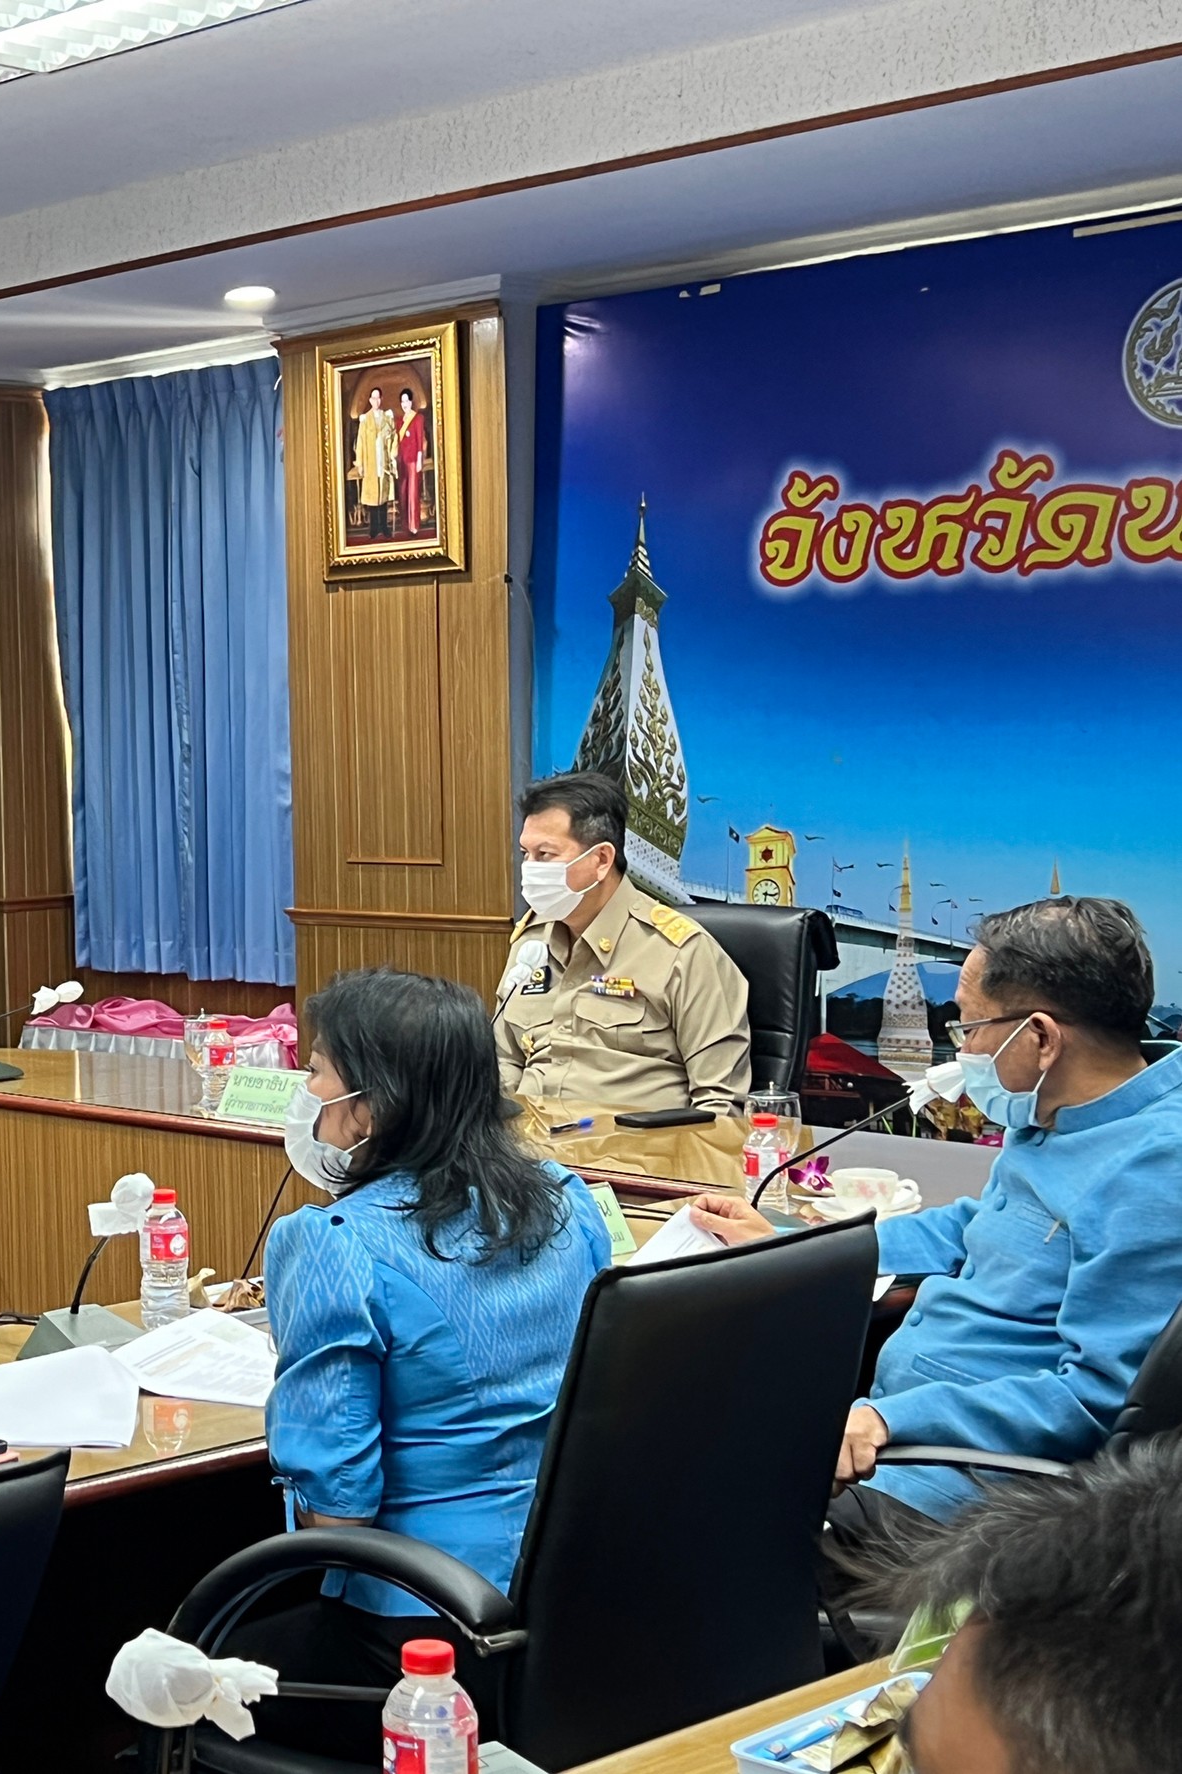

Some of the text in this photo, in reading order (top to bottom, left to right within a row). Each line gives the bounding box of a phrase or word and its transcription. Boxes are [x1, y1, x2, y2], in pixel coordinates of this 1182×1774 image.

[224, 1094, 288, 1114] ผู้ว่าราชการจังห
